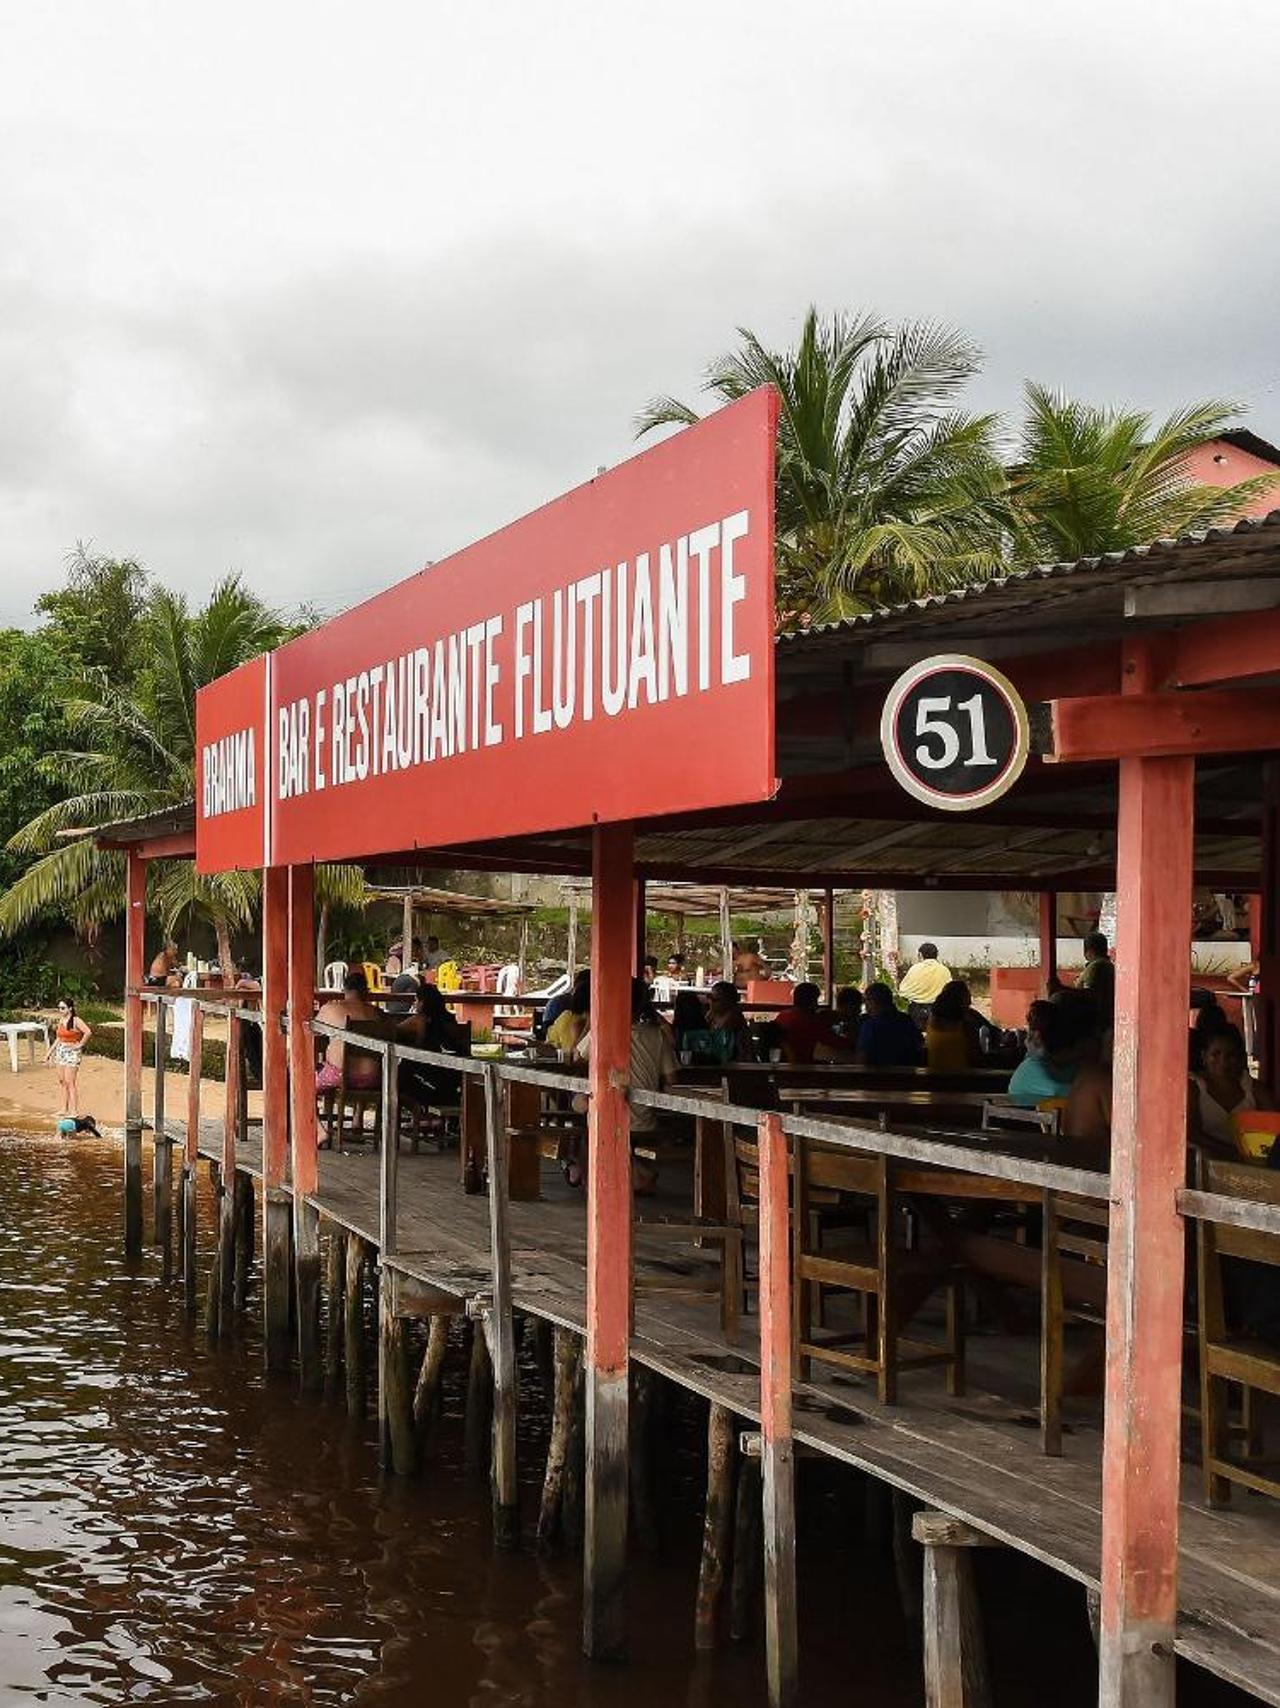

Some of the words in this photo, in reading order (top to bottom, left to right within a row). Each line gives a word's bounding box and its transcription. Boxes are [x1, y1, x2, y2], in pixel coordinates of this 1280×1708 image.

[278, 697, 310, 800] BAR
[315, 689, 326, 791] E
[332, 614, 503, 786] RESTAURANTE
[514, 509, 751, 739] FLUTUANTE
[202, 727, 257, 819] BRAHMA
[915, 694, 998, 769] 51
